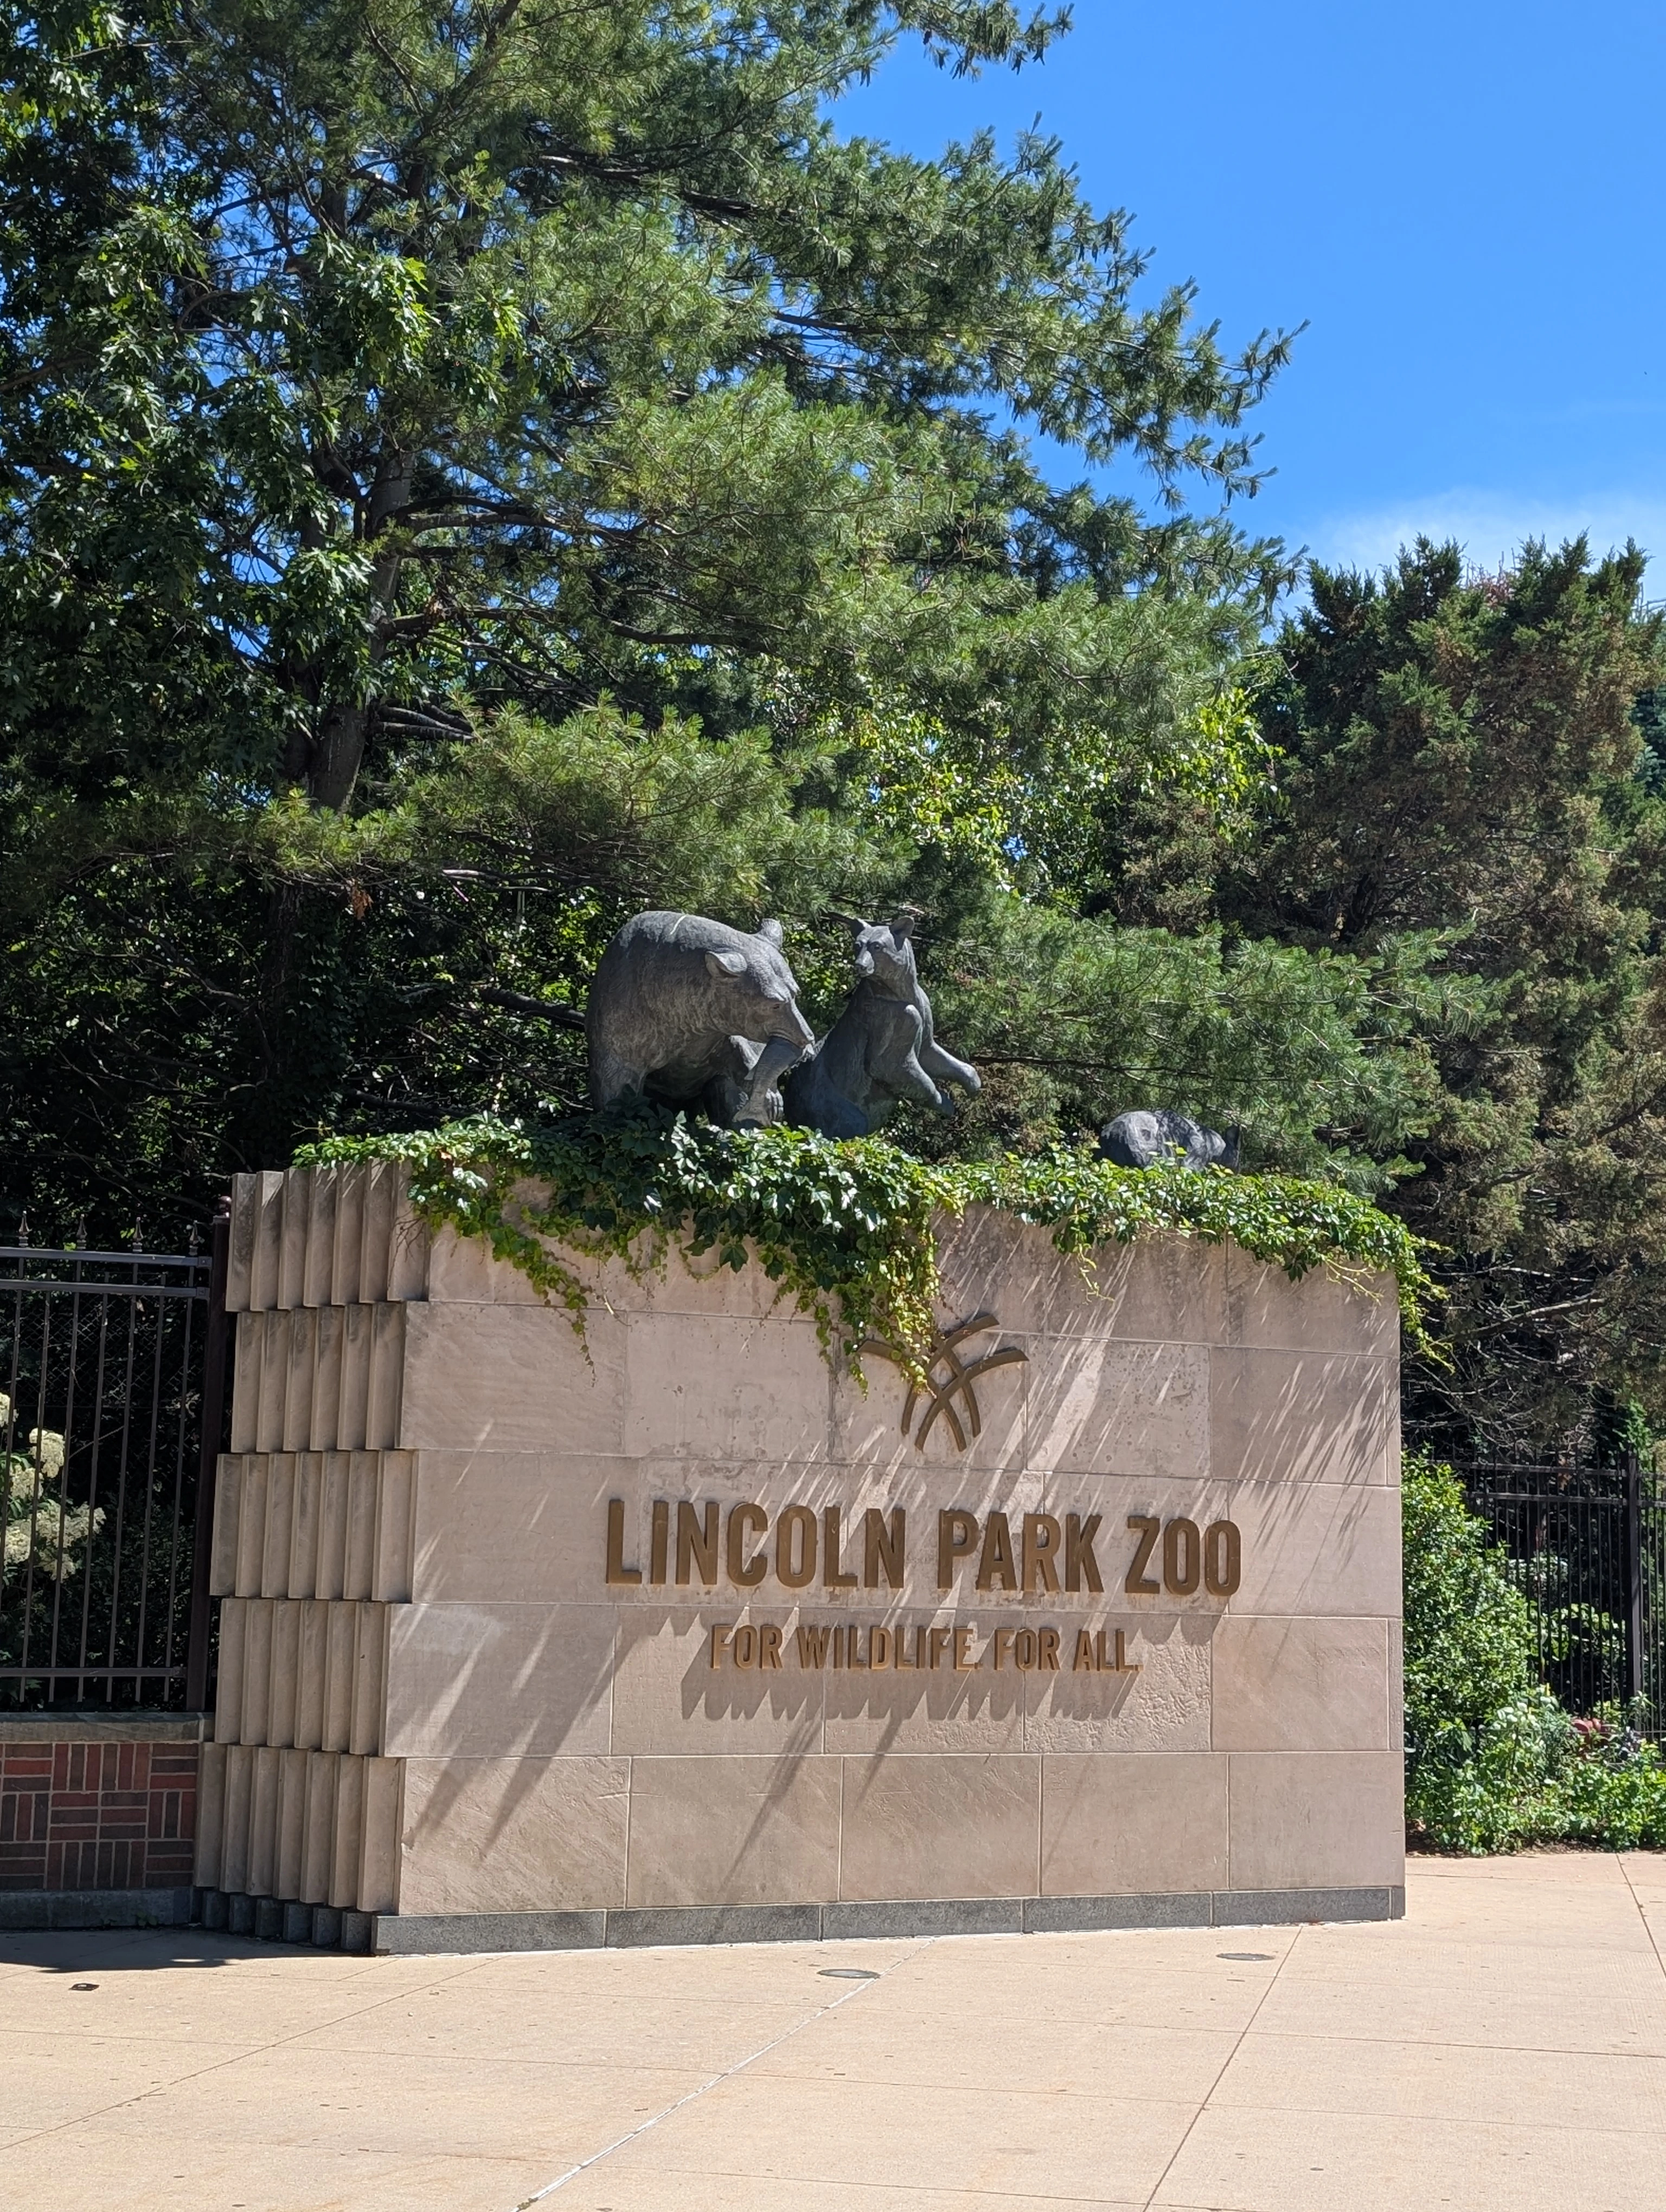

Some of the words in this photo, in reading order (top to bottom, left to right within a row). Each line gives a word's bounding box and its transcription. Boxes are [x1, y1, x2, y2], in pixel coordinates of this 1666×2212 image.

[606, 1499, 906, 1589] LINCOLN
[937, 1509, 1105, 1593] PARK
[1125, 1516, 1241, 1597] ZOO
[710, 1624, 783, 1669] FOR
[994, 1628, 1061, 1671] FOR
